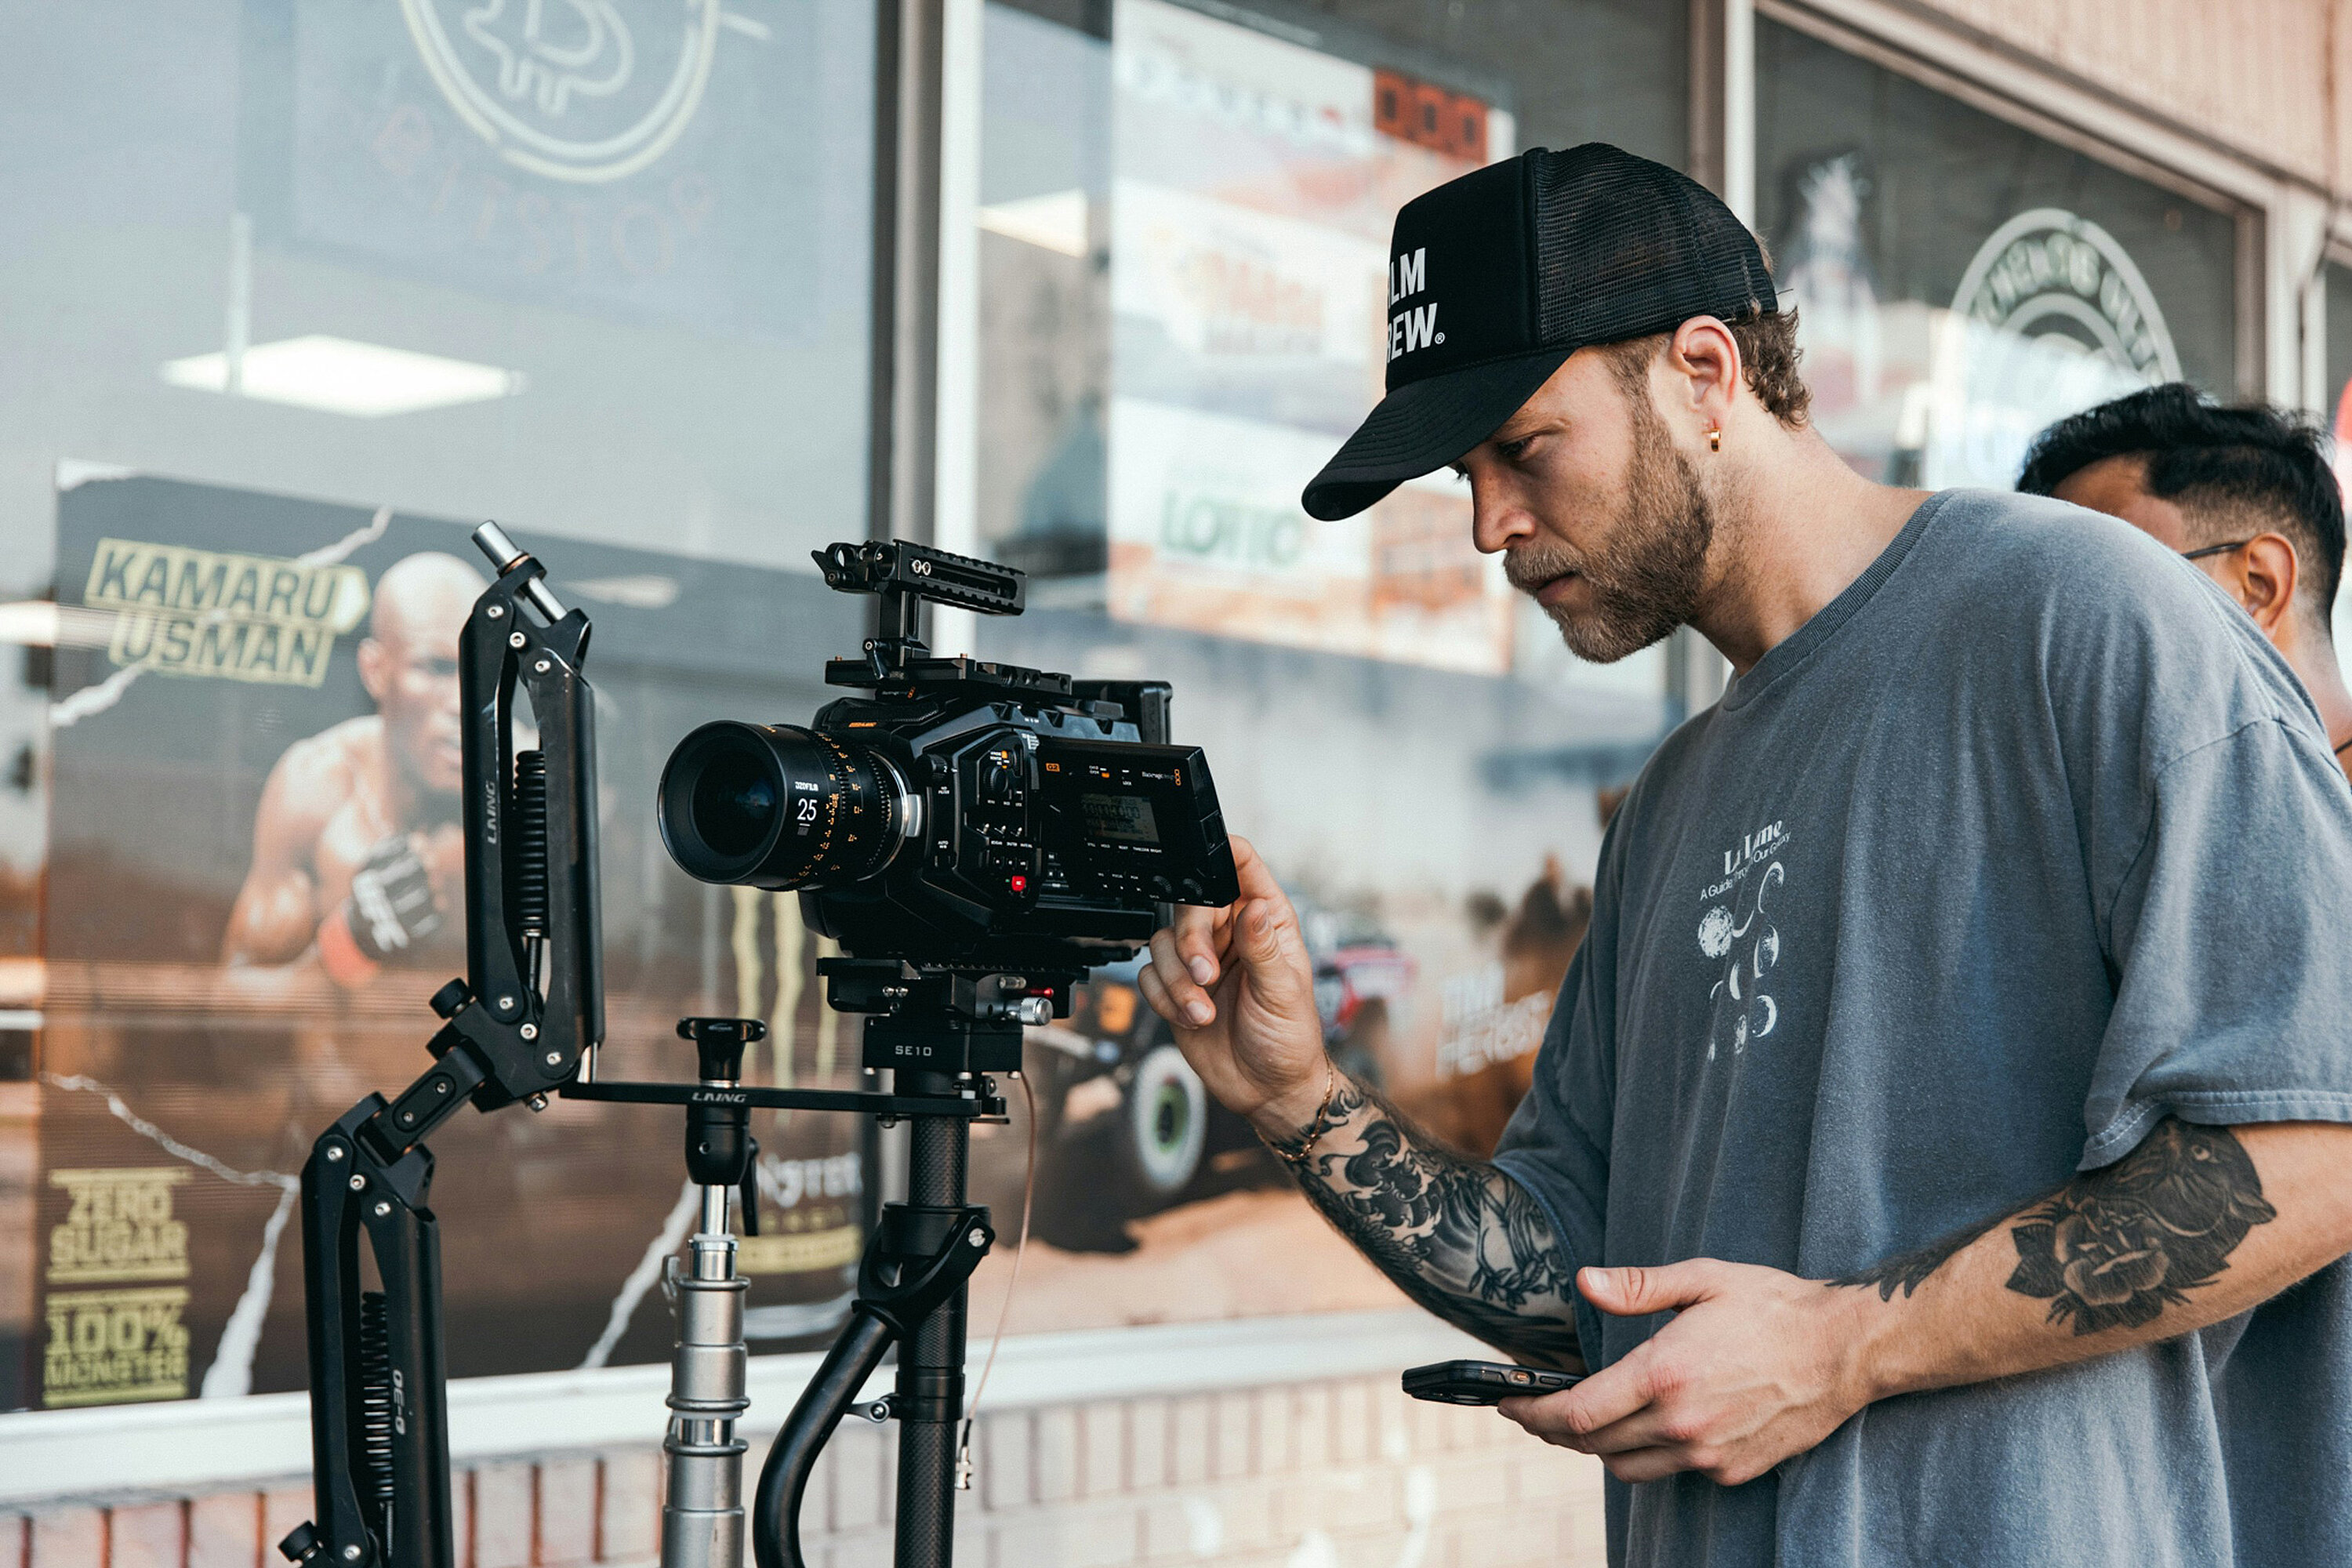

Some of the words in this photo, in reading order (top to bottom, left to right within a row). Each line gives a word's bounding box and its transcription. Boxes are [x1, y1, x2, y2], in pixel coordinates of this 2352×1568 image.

[99, 547, 337, 621] KAMARU
[122, 608, 323, 677] USMAN
[797, 798, 818, 821] 25
[1700, 888, 1708, 902] A
[1708, 878, 1733, 897] Guide
[1753, 848, 1769, 862] Our
[67, 1182, 173, 1222] ZERO
[49, 1221, 189, 1265] SUGAR
[45, 1308, 189, 1353] 100%
